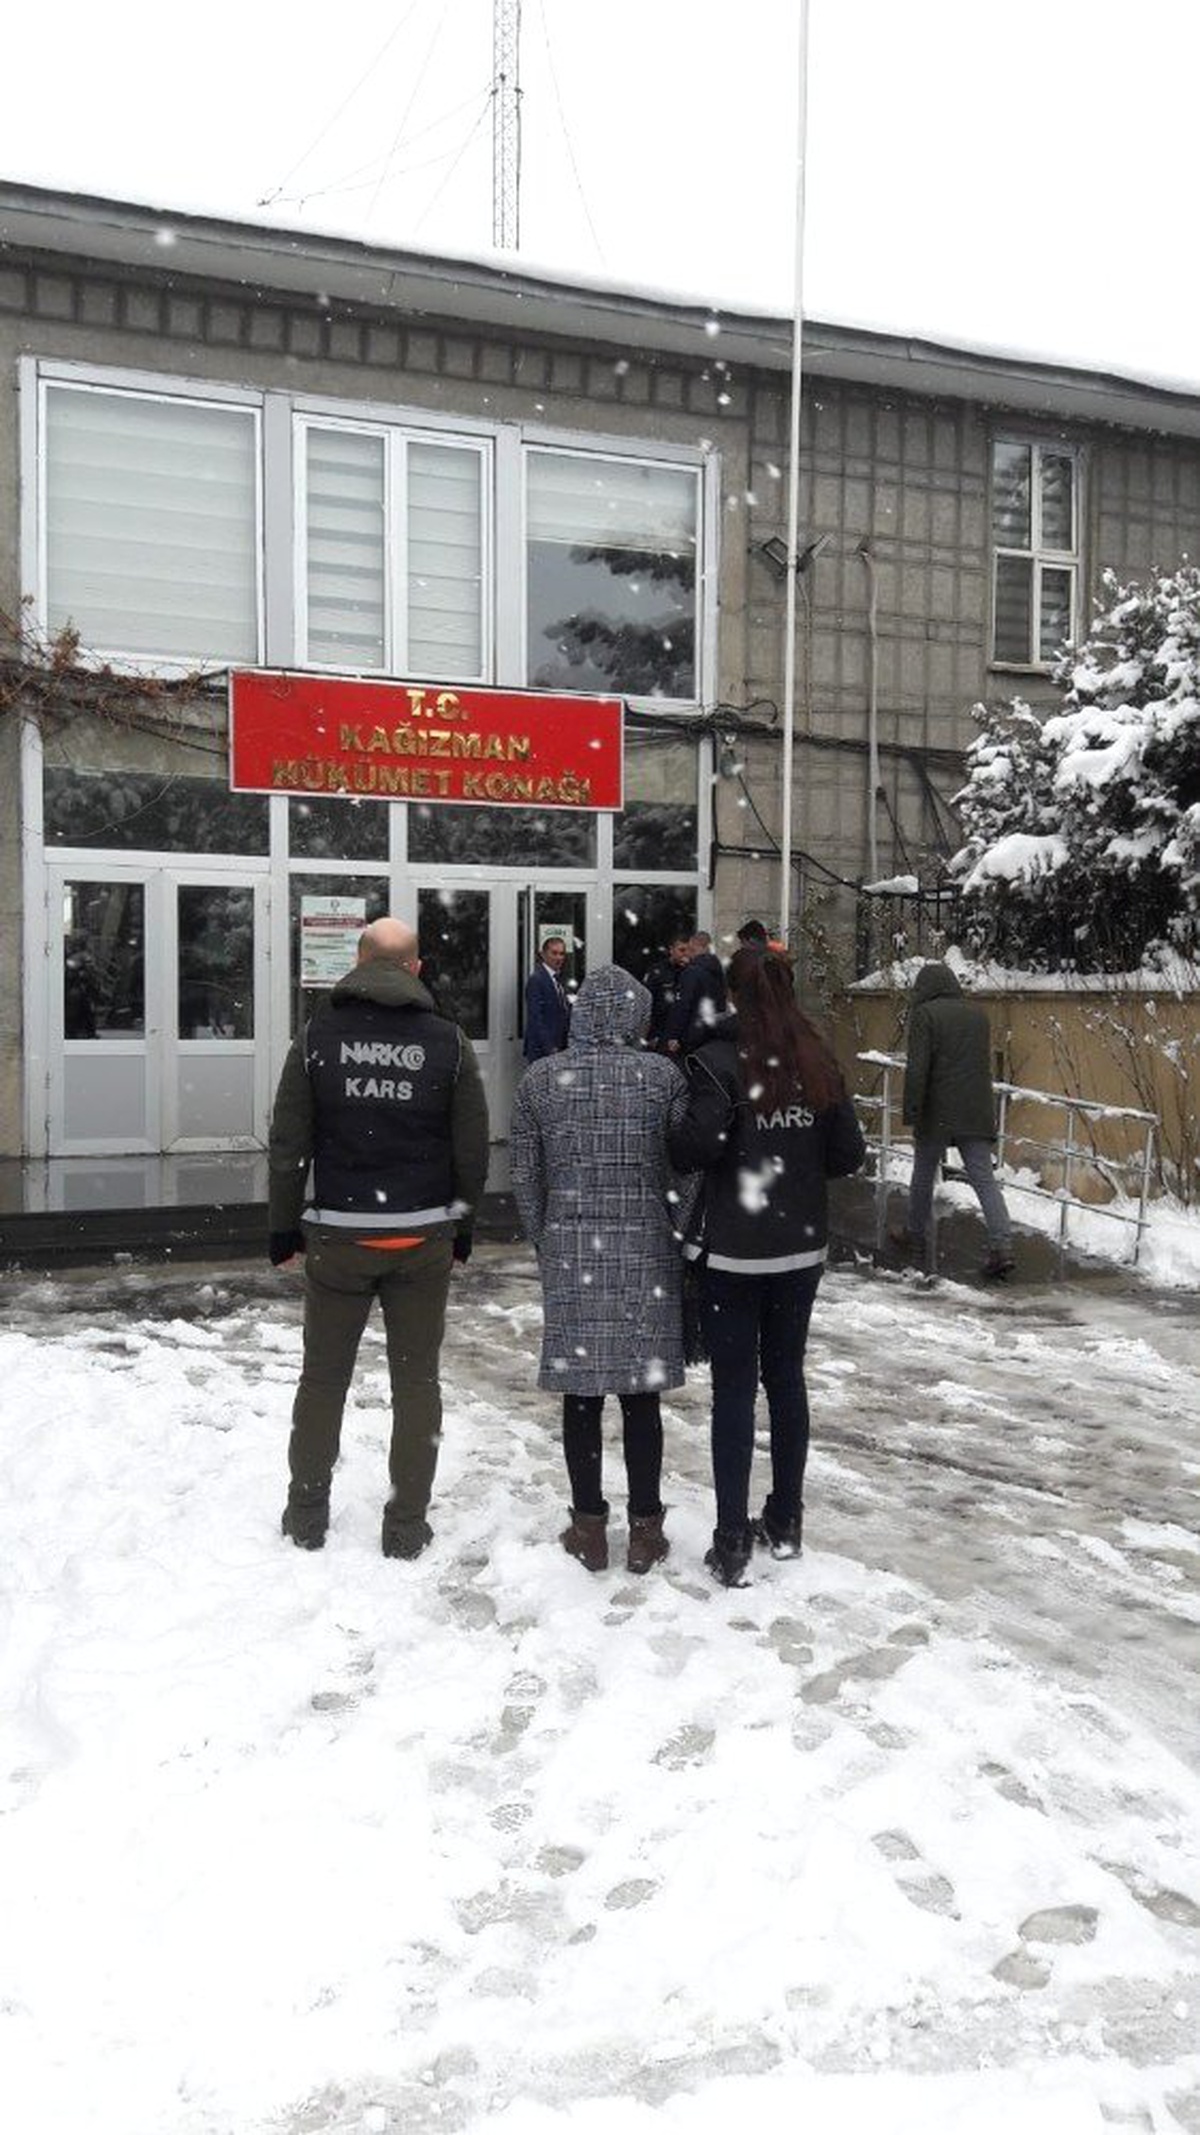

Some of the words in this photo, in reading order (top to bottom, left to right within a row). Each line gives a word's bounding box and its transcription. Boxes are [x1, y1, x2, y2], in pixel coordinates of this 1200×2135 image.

[406, 689, 468, 721] T.C.
[340, 722, 531, 761] KAĞIZMAN
[272, 753, 453, 796] HÜKÜMET
[463, 769, 591, 804] KONAĞI
[346, 1078, 413, 1100] KARS
